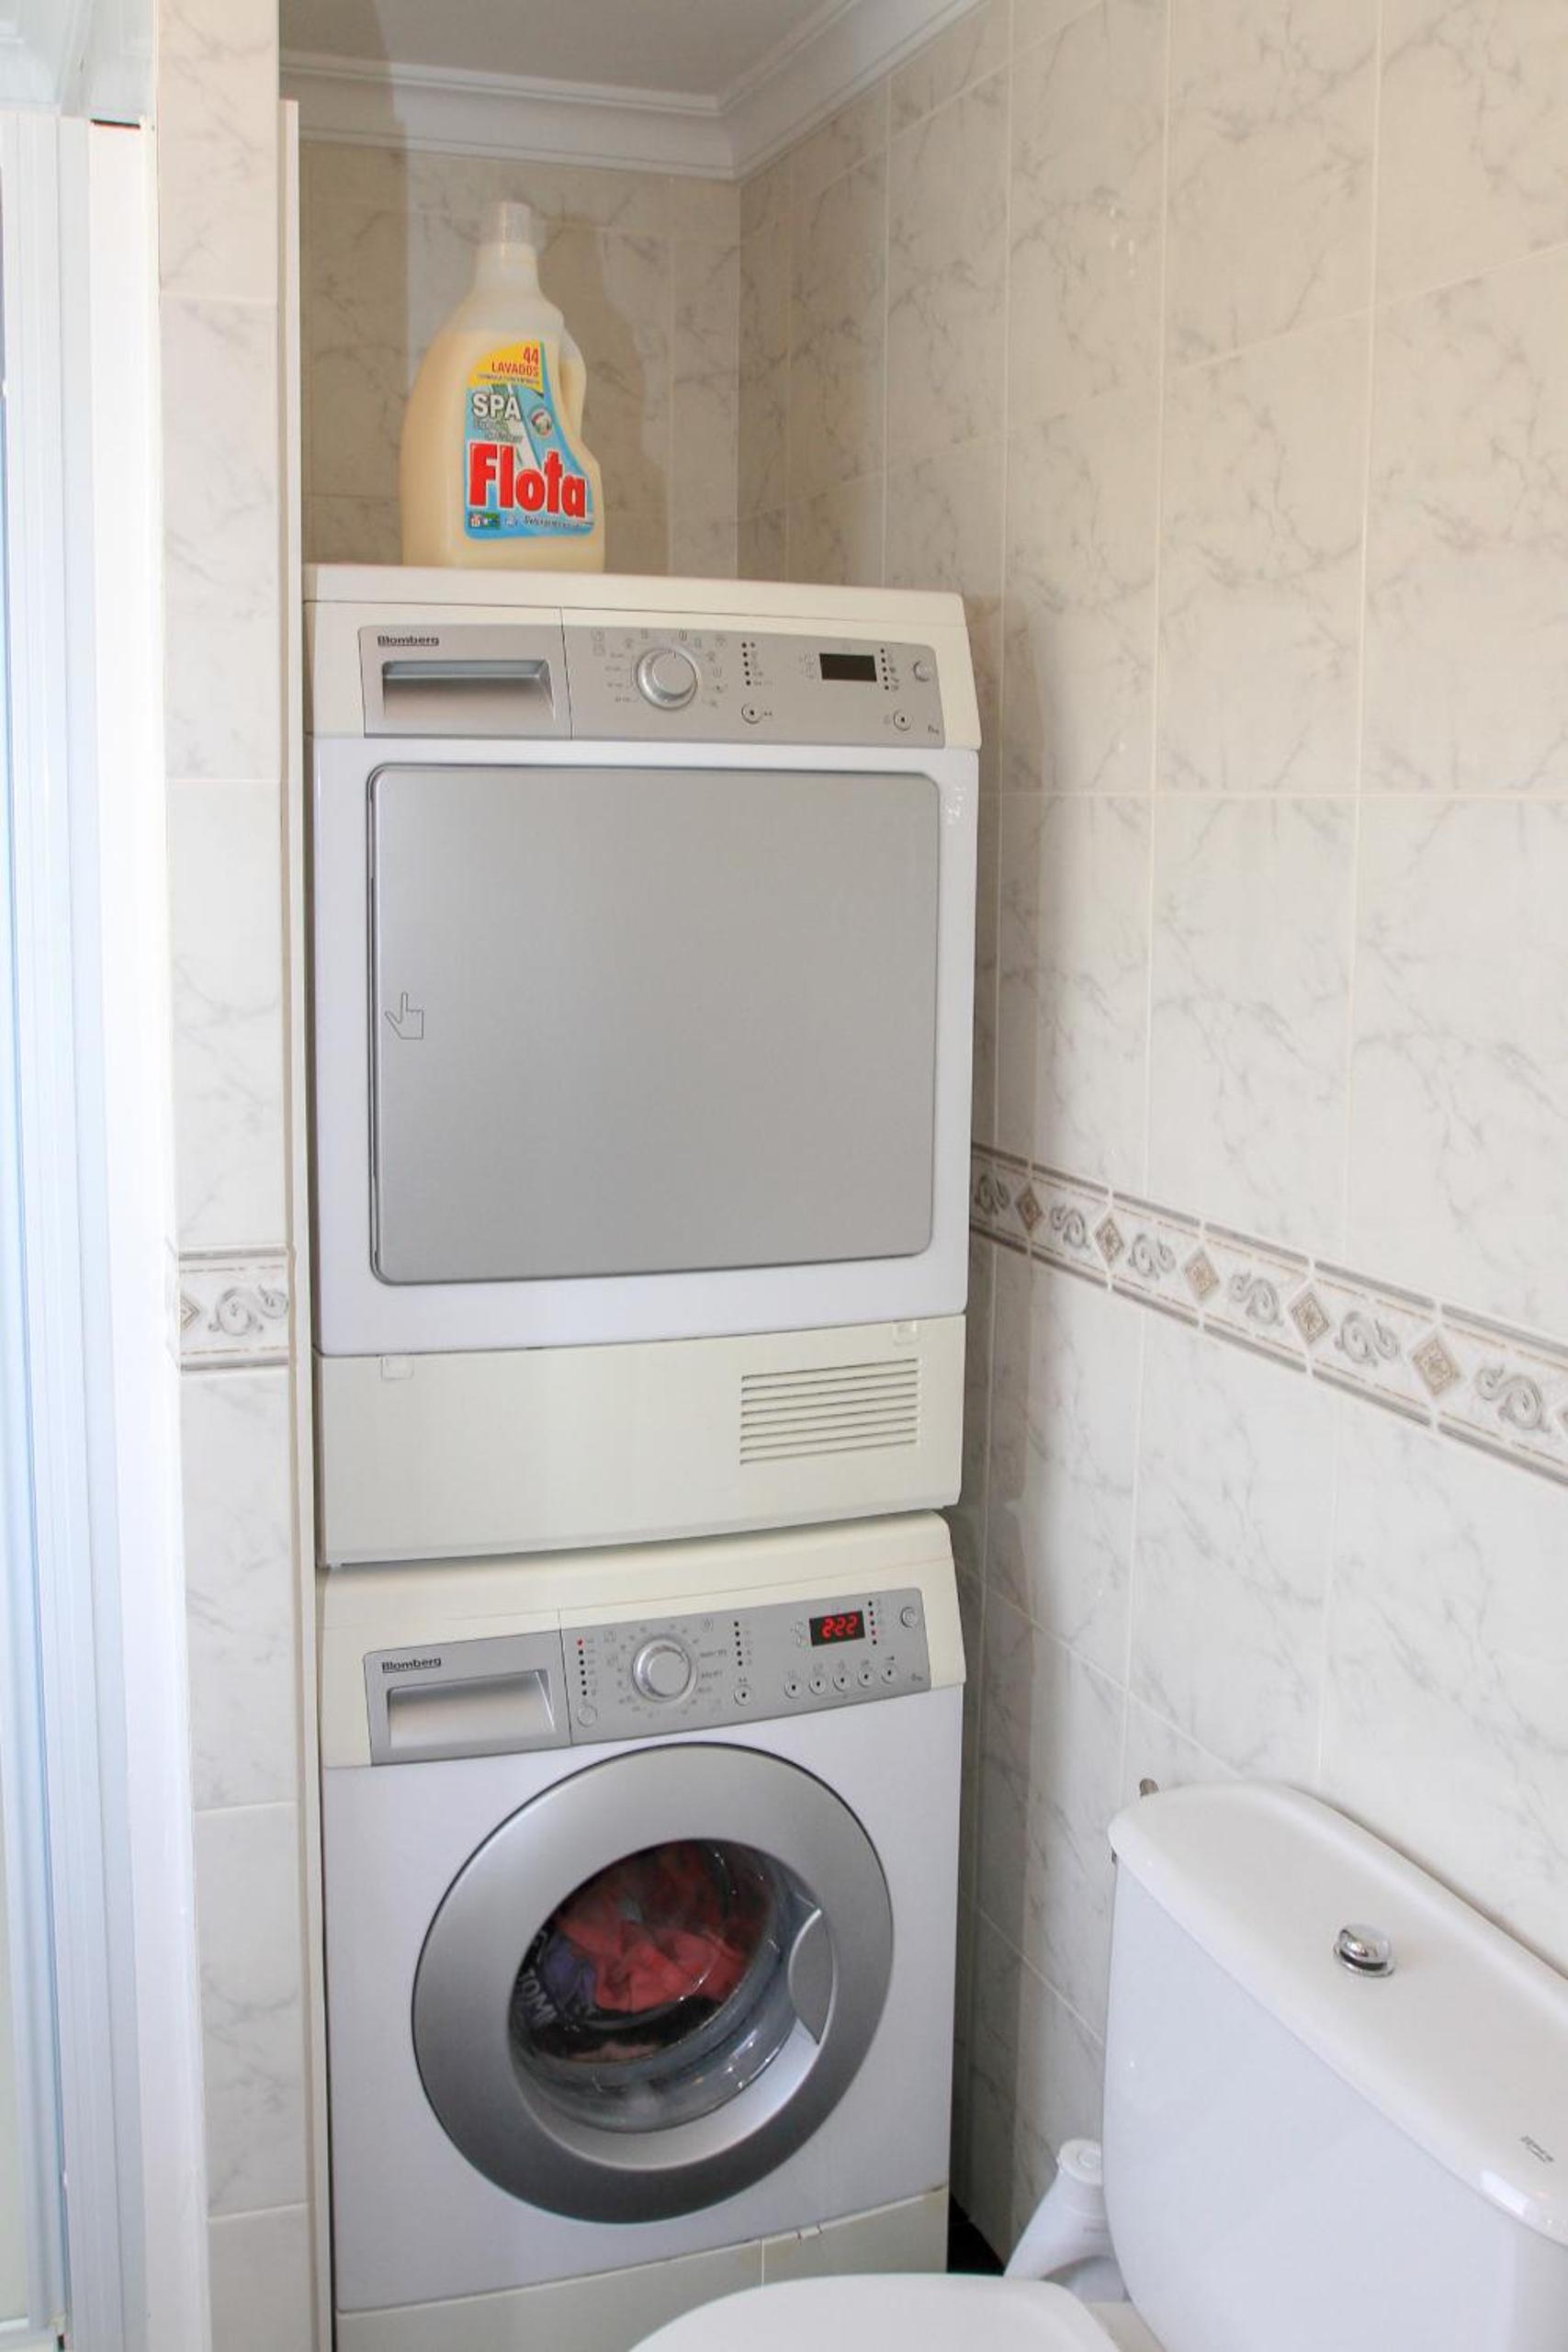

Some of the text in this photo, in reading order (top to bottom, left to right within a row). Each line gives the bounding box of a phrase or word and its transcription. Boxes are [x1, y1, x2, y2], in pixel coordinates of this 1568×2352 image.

[524, 346, 539, 365] 44
[491, 361, 538, 377] LAVADOS
[471, 392, 522, 421] SPA
[469, 443, 585, 518] Flota
[378, 632, 440, 647] Blomberg
[382, 1657, 442, 1673] Blomberg
